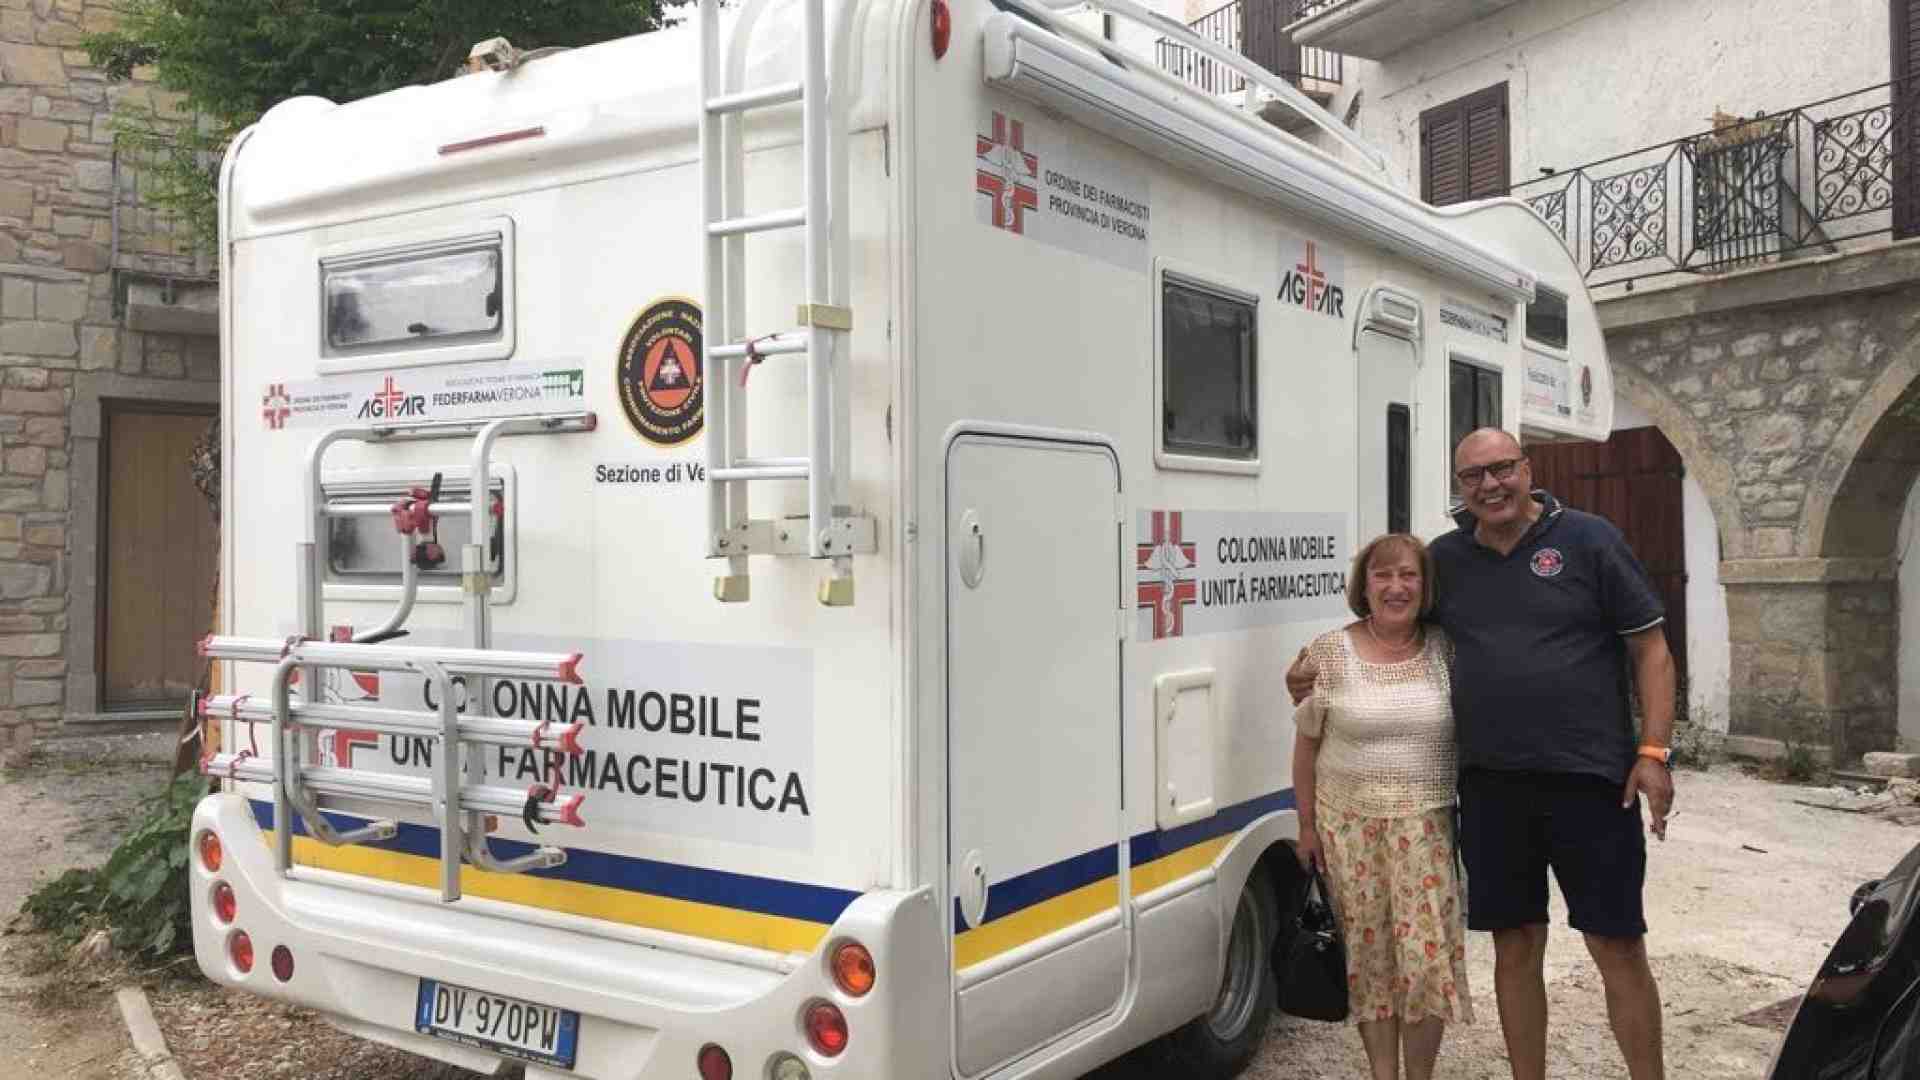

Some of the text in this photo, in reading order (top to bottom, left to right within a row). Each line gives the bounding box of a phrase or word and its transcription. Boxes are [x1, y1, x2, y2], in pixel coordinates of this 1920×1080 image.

[595, 463, 705, 483] Sezione di Ve
[1217, 535, 1336, 564] COLONNA MOBILE
[1250, 571, 1346, 604] FARMACEUTICA
[423, 676, 761, 741] CONNA MOBILE
[498, 743, 811, 816] FARMACEUTICA
[436, 987, 467, 1028] DV
[476, 996, 558, 1051] 970PW
